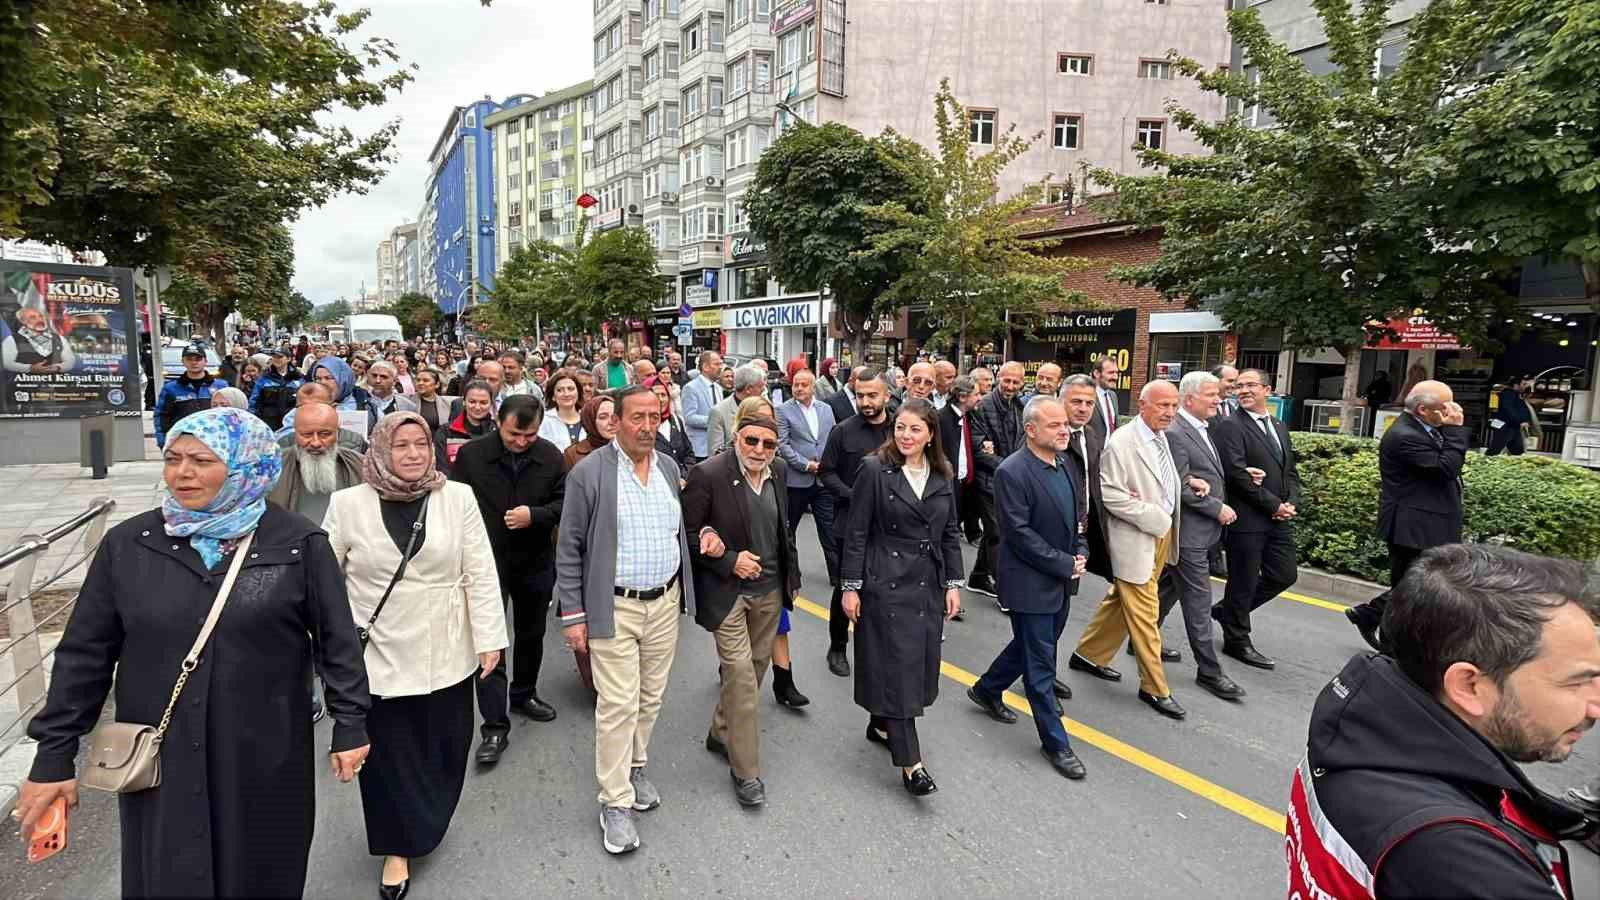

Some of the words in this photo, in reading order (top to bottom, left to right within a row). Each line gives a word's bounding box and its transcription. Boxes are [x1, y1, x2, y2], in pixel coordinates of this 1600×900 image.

[47, 282, 120, 299] KUDÜS
[735, 309, 752, 328] LC
[1076, 314, 1114, 328] Center
[14, 373, 53, 383] Ahmet
[56, 373, 92, 385] Kürşat
[95, 374, 125, 383] Batur
